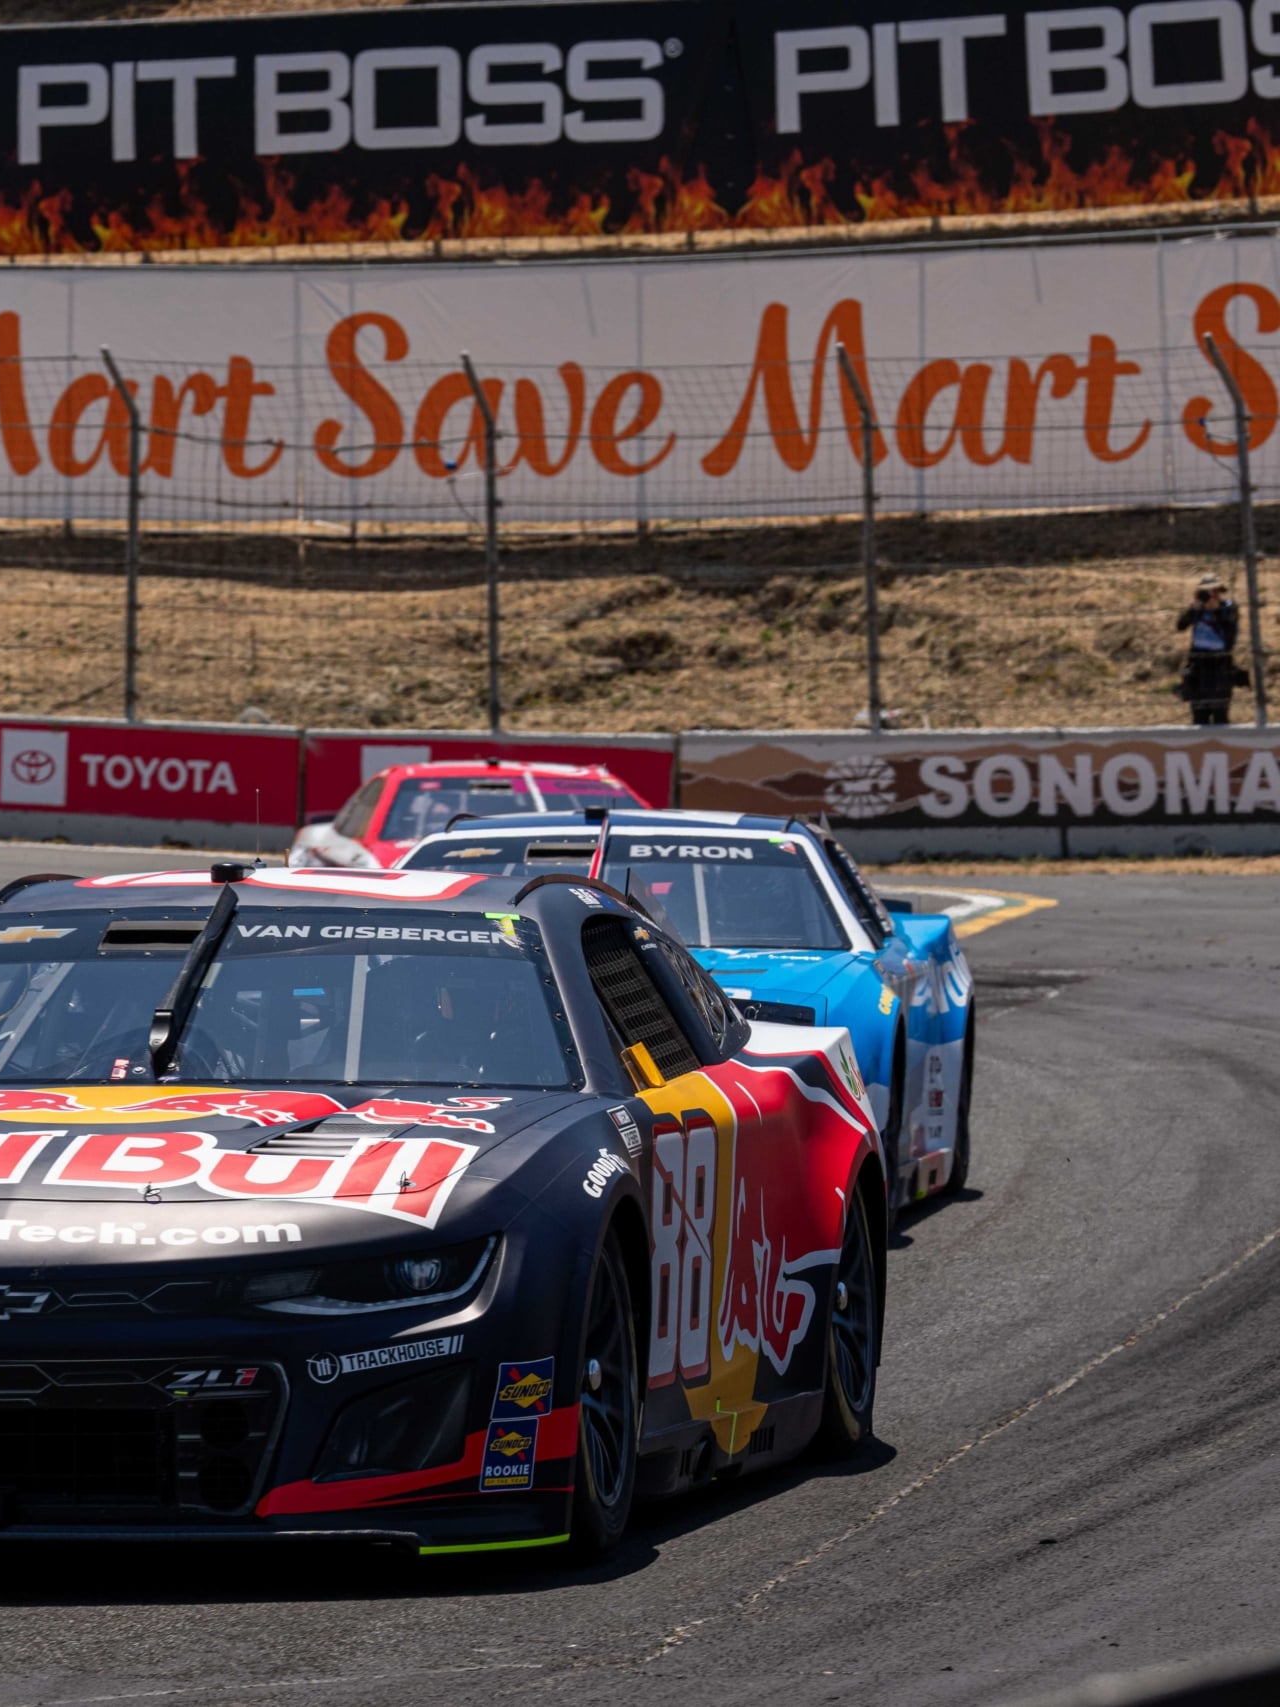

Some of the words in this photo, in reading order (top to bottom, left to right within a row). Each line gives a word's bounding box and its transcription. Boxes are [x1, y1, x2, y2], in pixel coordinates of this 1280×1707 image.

[775, 16, 1006, 133] PIT
[18, 56, 236, 164] PIT
[314, 312, 676, 478] Save
[701, 299, 1152, 477] Mart
[79, 753, 238, 795] TOYOTA
[919, 752, 1280, 818] SONOMA
[629, 844, 753, 860] BYRON
[237, 924, 310, 938] VAN
[42, 1131, 480, 1230] Bull
[648, 1121, 718, 1388] 88
[345, 1338, 446, 1371] TRACKHOUSE
[165, 1367, 259, 1389] ZL1
[501, 1380, 551, 1400] SUNOCO
[491, 1438, 531, 1451] SUNOCO
[484, 1464, 530, 1477] ROOKIE
